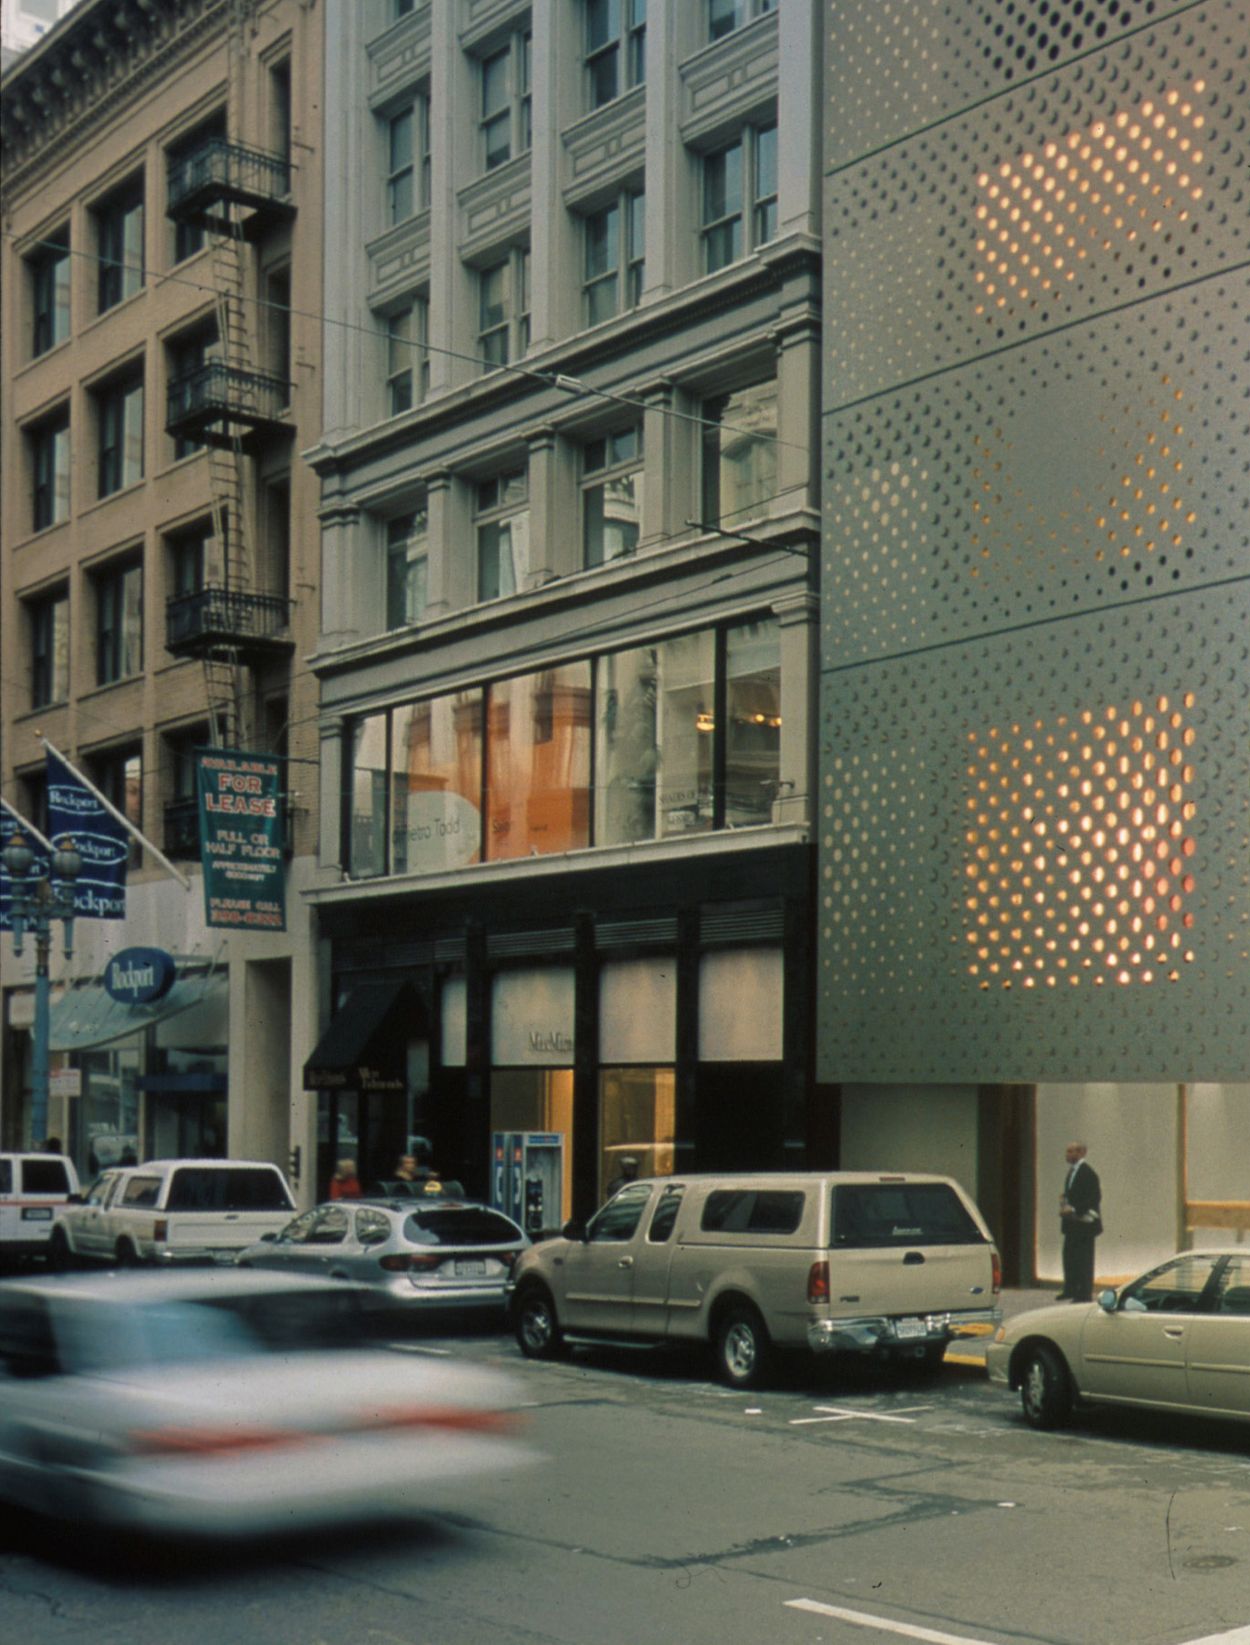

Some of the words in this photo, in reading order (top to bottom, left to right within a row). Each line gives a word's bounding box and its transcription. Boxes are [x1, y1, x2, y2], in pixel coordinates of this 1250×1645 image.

[218, 773, 262, 795] FOR
[205, 792, 277, 818] LEASE
[70, 838, 115, 858] ockport
[217, 830, 247, 844] FULL
[250, 834, 270, 847] OR
[241, 846, 281, 859] FLOOR
[112, 961, 153, 997] Rockport
